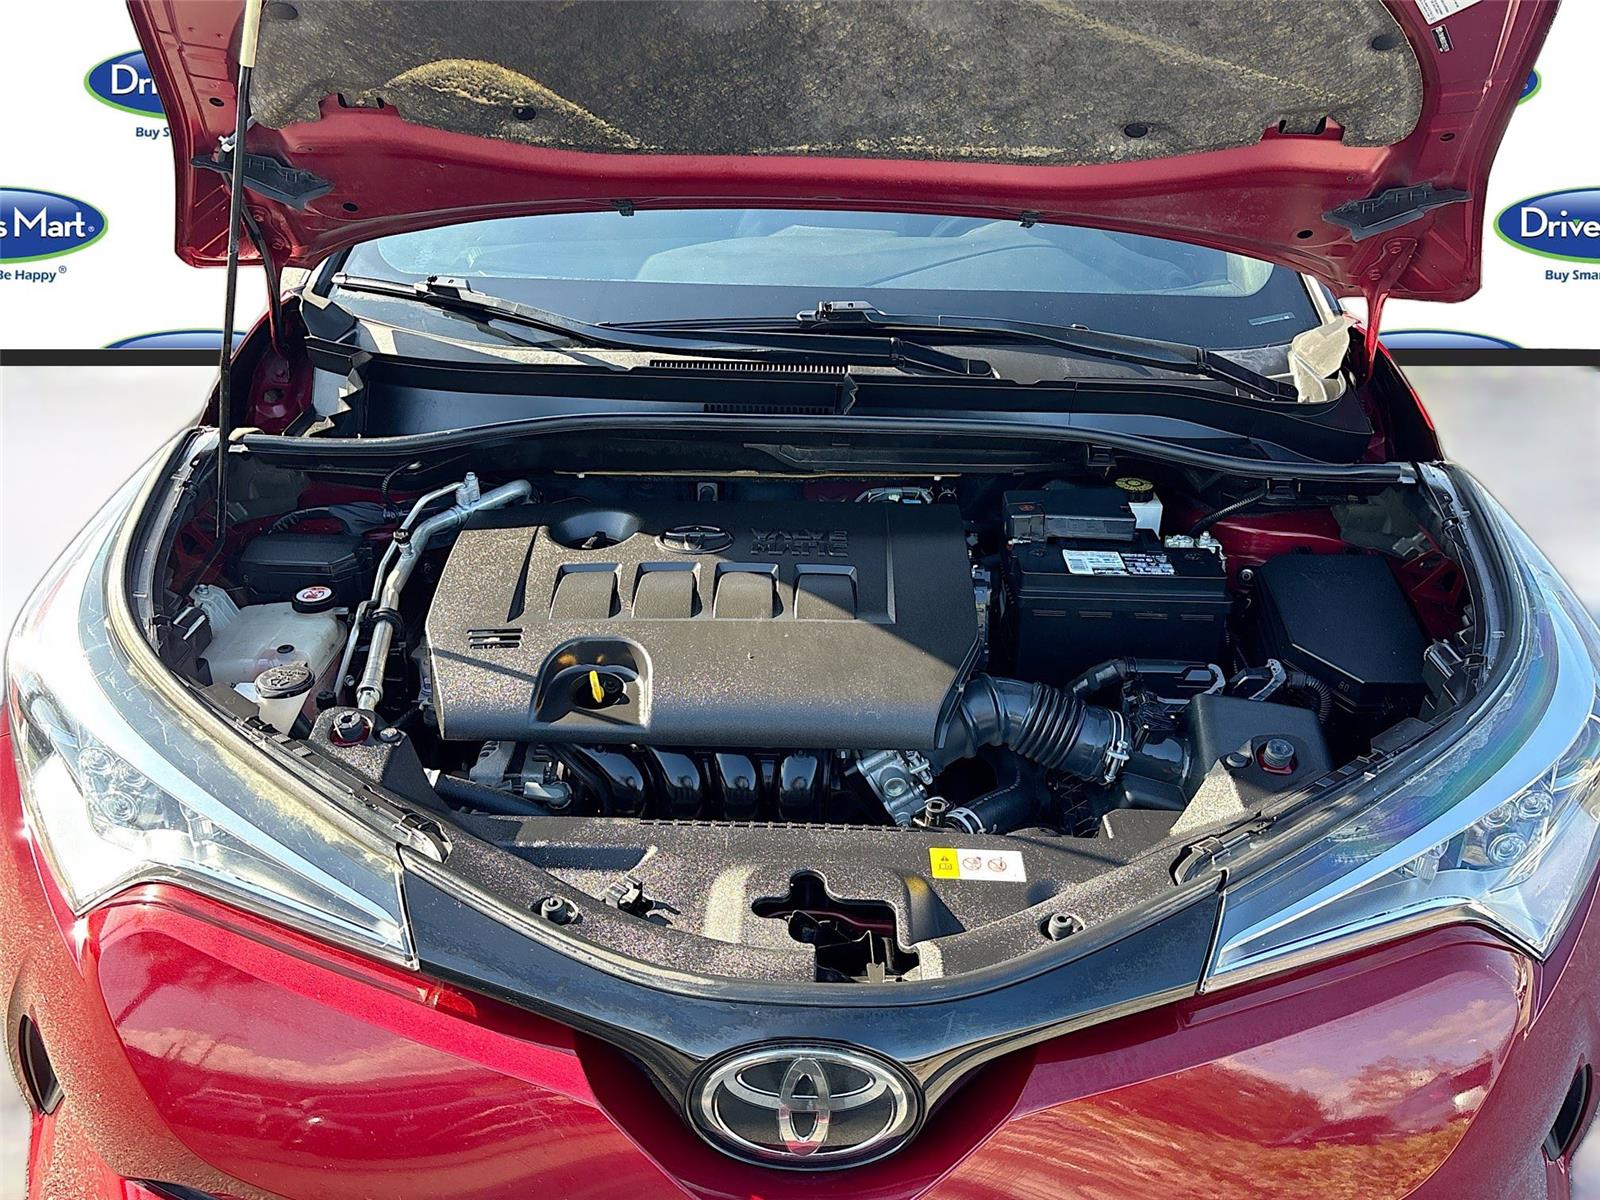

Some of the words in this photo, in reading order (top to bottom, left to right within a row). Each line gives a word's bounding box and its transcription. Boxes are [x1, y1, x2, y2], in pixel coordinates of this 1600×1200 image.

[135, 126, 160, 141] Buy
[13, 206, 86, 238] Mart
[1520, 206, 1600, 238] Drive
[14, 269, 57, 283] Happy
[1545, 269, 1570, 283] Buy
[1572, 269, 1600, 281] Sma
